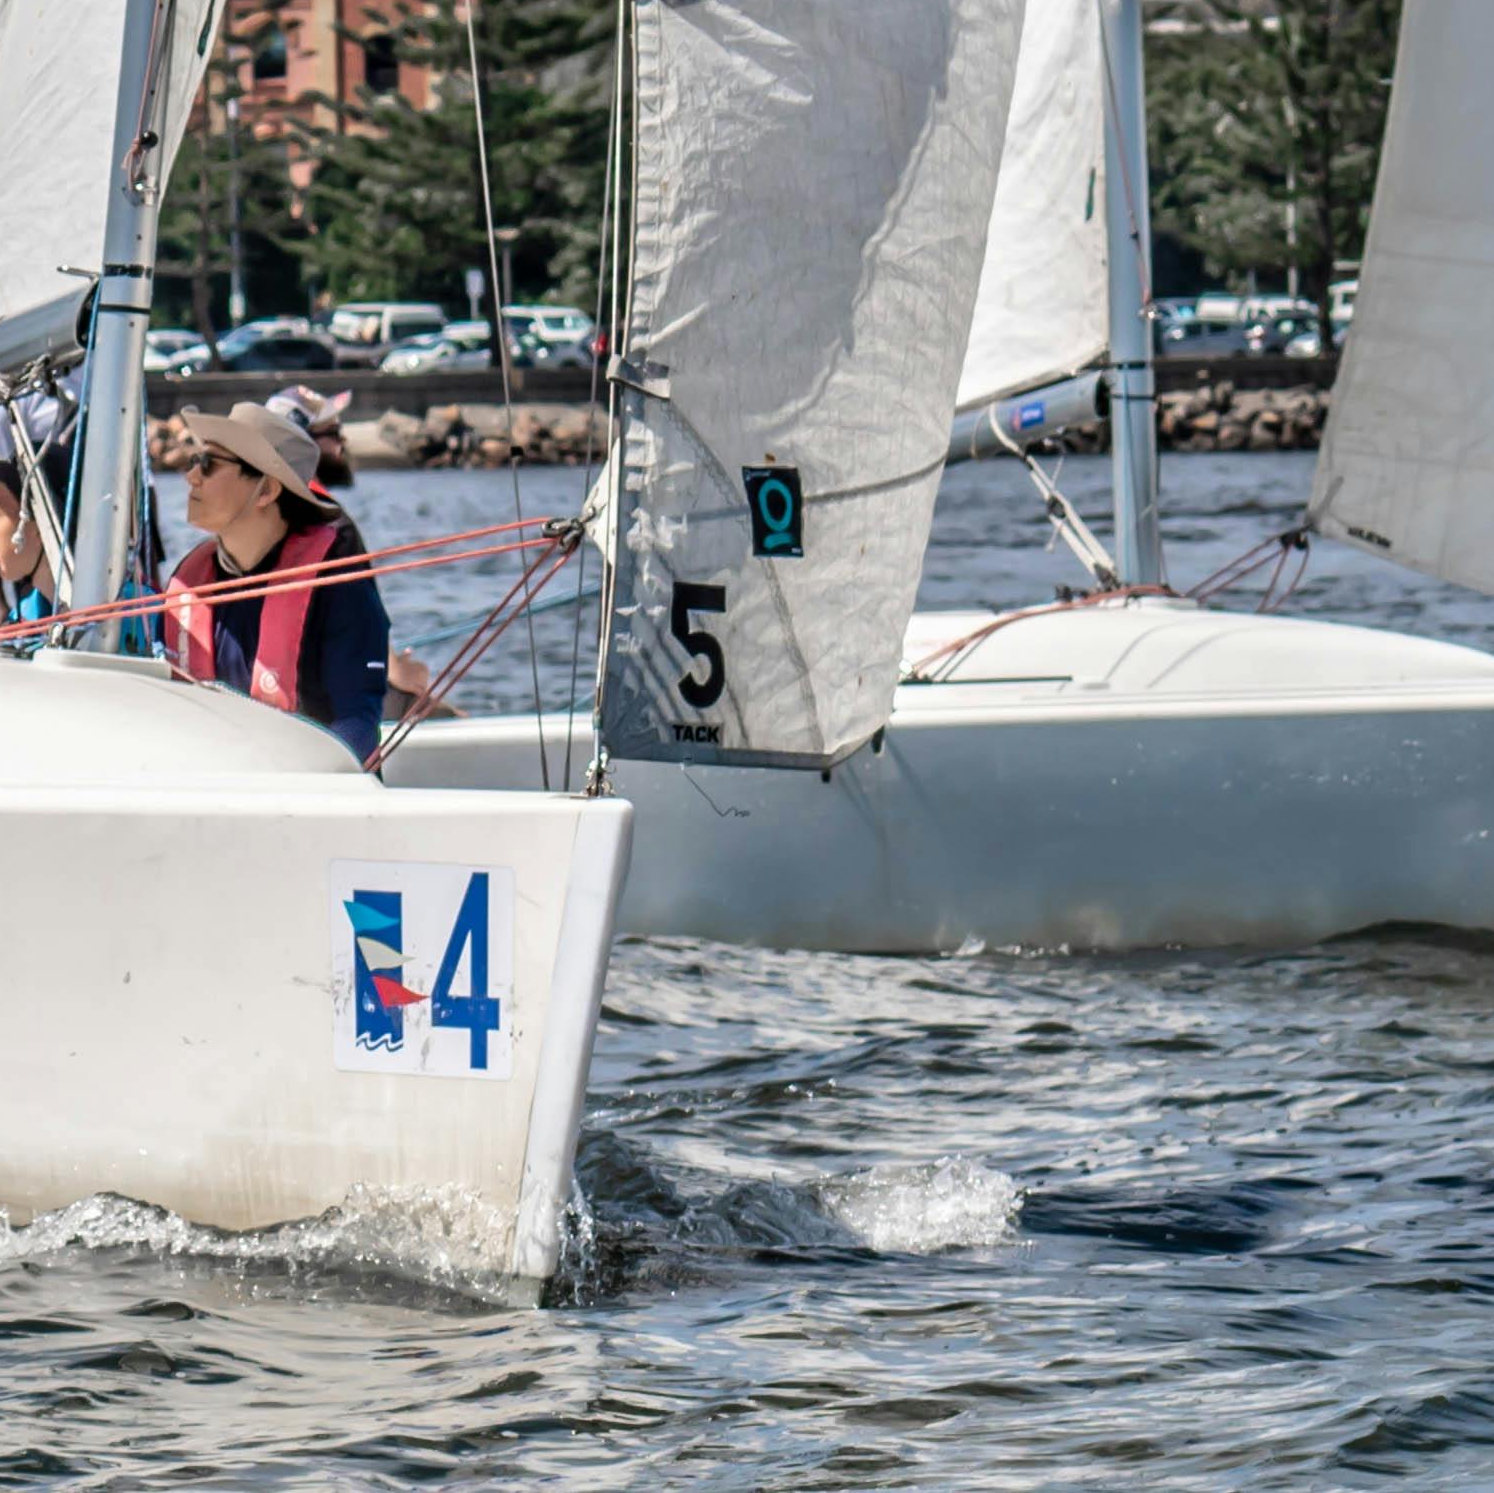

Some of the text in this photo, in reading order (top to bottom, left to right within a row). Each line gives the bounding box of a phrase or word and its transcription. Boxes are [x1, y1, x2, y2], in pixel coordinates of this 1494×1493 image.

[671, 581, 726, 709] 5
[673, 723, 720, 744] TACK
[431, 872, 500, 1070] 4
